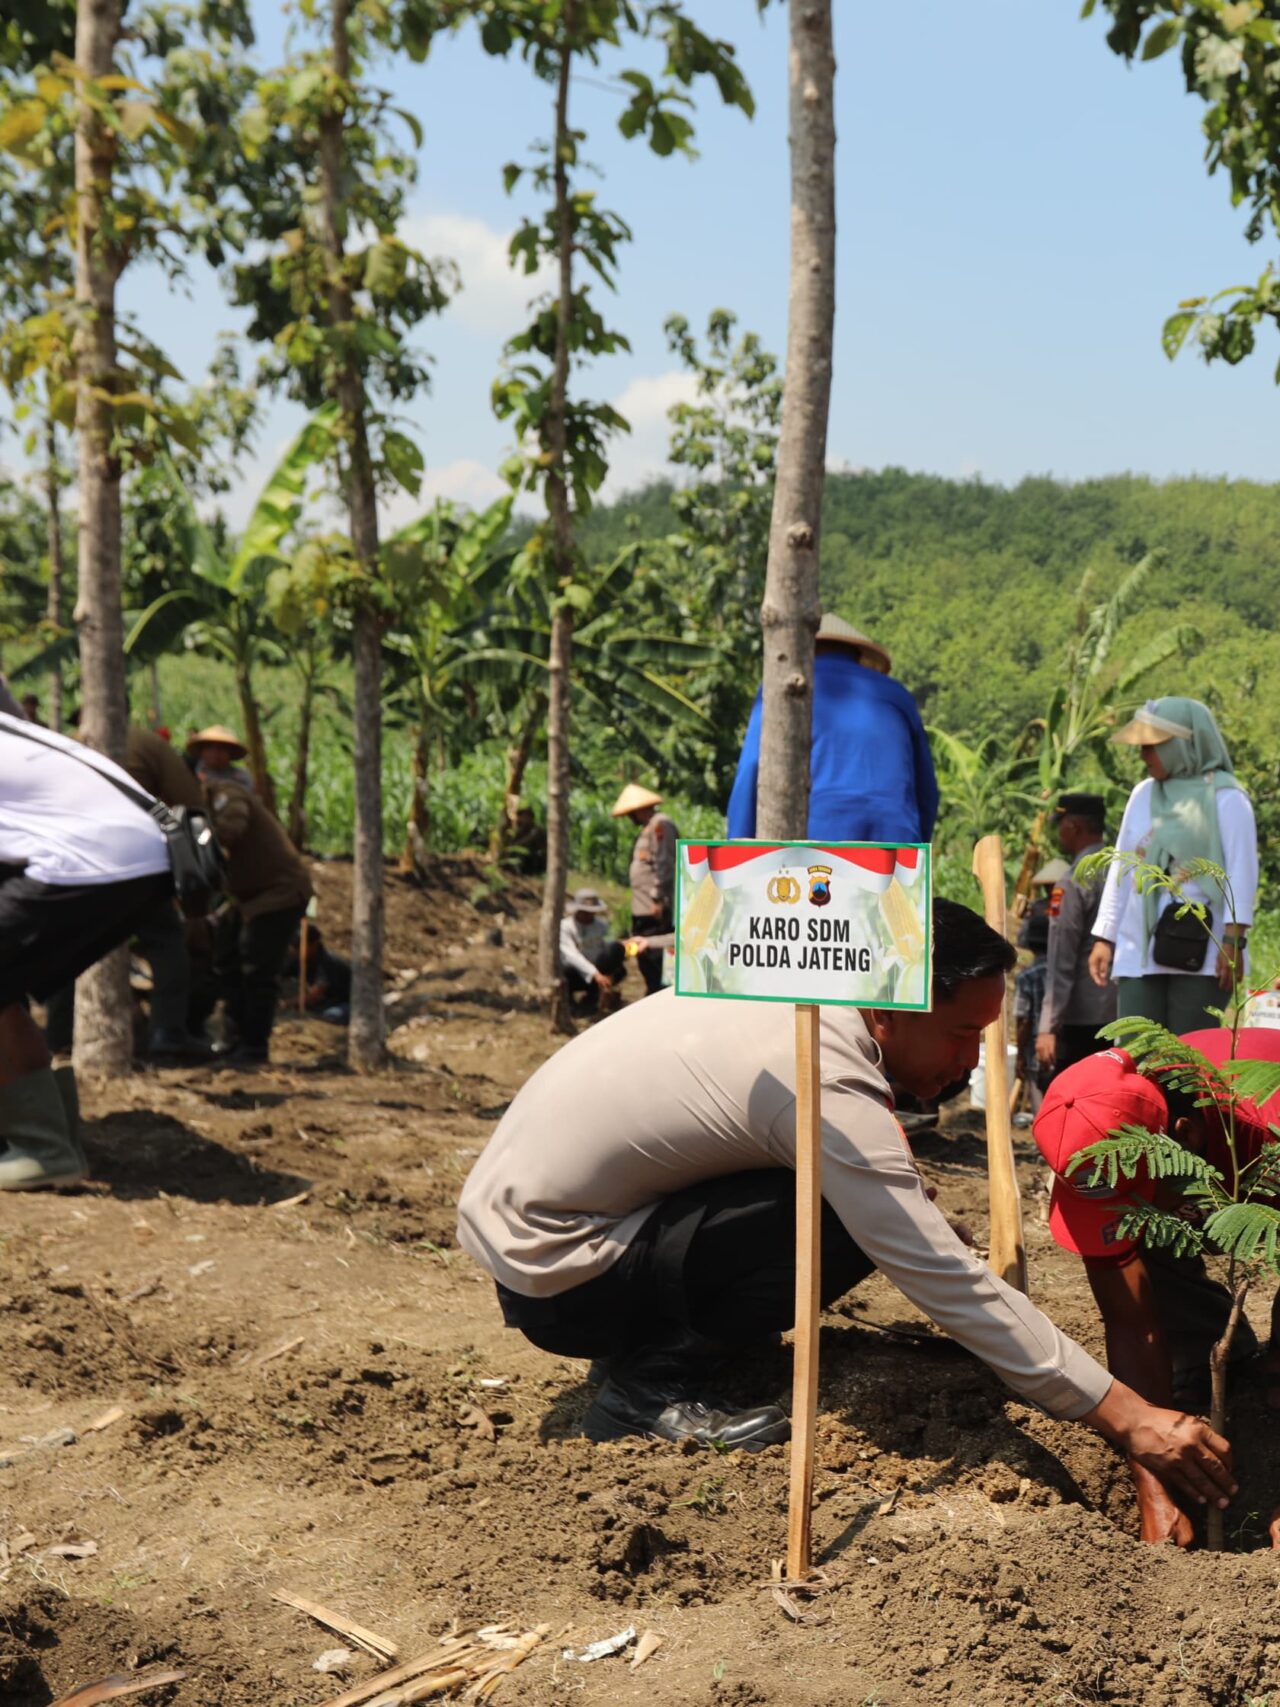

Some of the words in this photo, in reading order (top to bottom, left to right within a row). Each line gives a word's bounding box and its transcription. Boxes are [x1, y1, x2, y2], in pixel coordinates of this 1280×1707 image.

[749, 916, 800, 942] KARO
[807, 918, 850, 943] SDM
[729, 943, 791, 969] POLDA
[797, 945, 871, 973] JATENG
